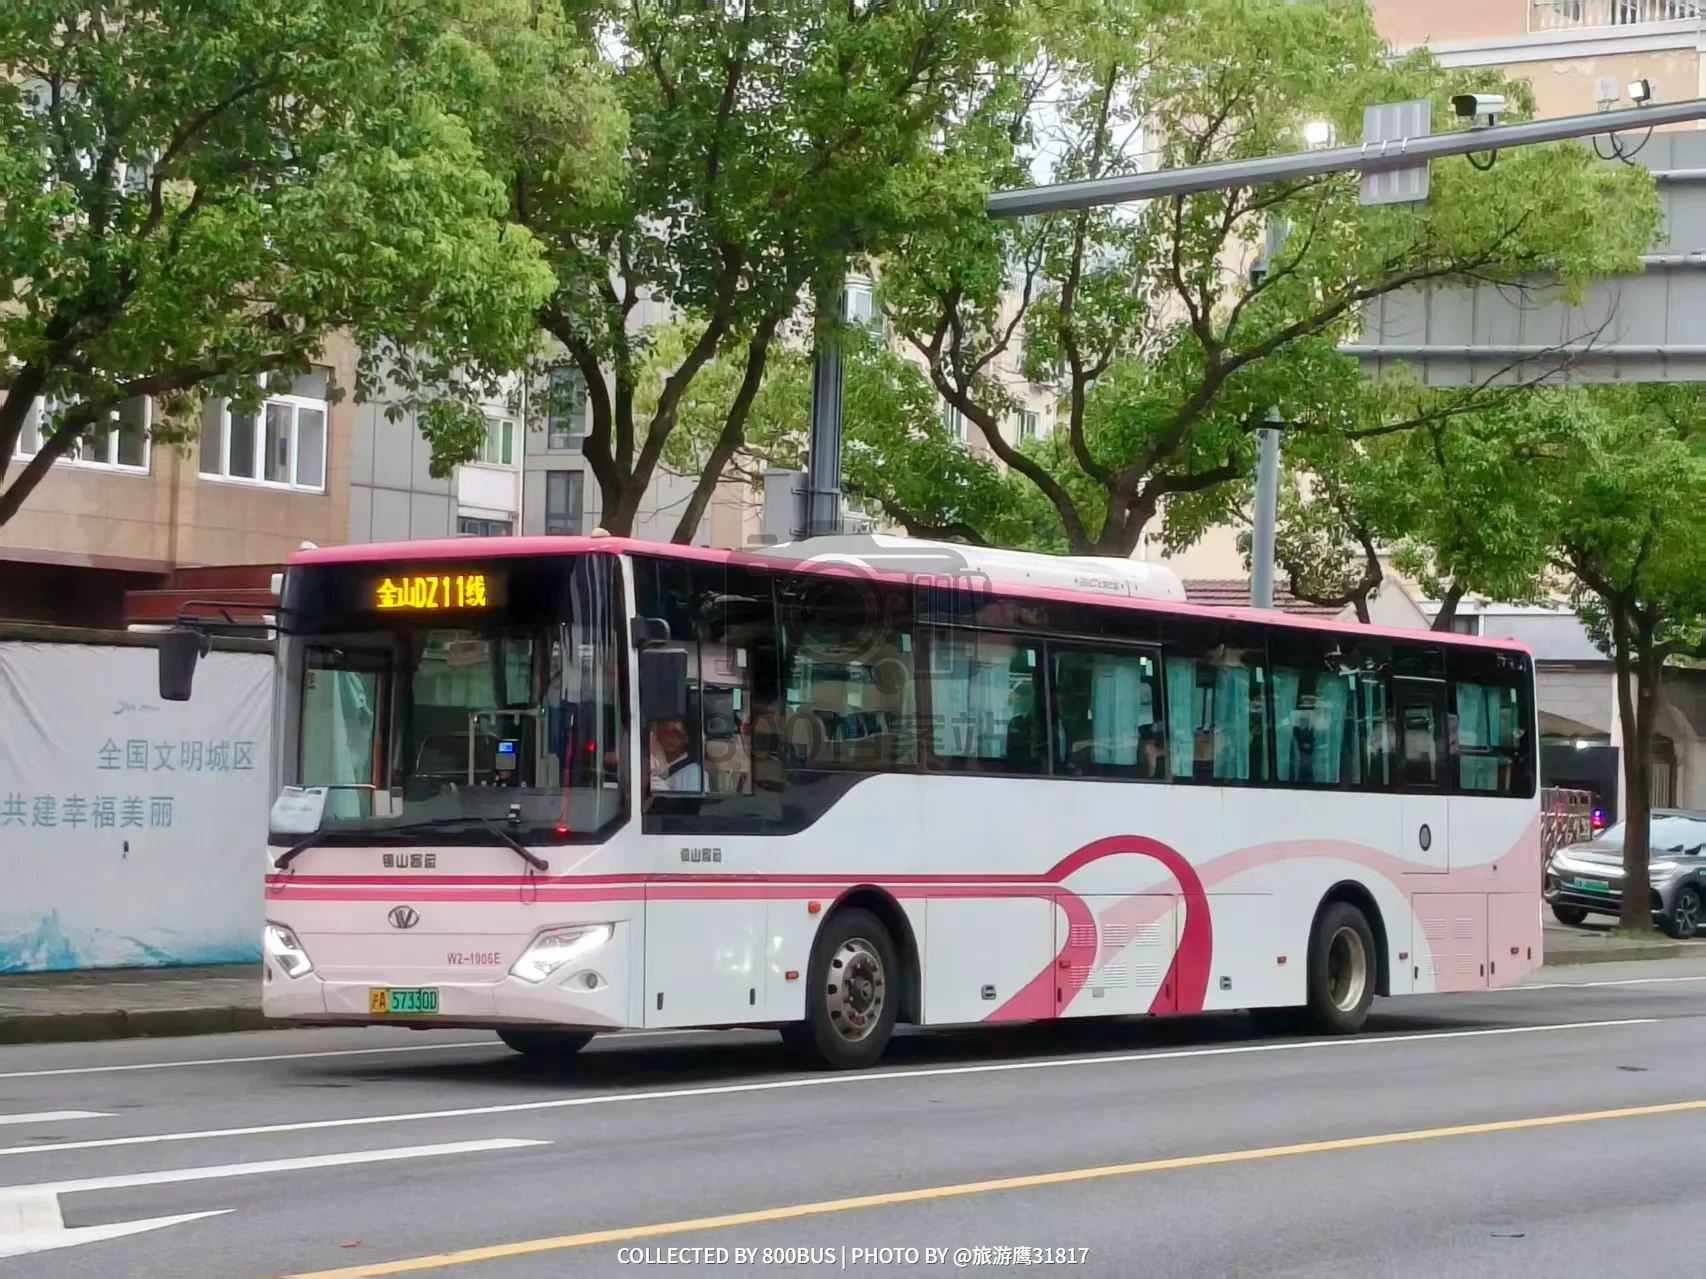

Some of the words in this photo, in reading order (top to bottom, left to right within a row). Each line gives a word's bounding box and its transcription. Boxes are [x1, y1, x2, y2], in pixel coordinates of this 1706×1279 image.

[376, 575, 486, 608] 金山DZ11线
[97, 738, 255, 771] 全国文明城区
[0, 792, 175, 828] 共建幸福美丽
